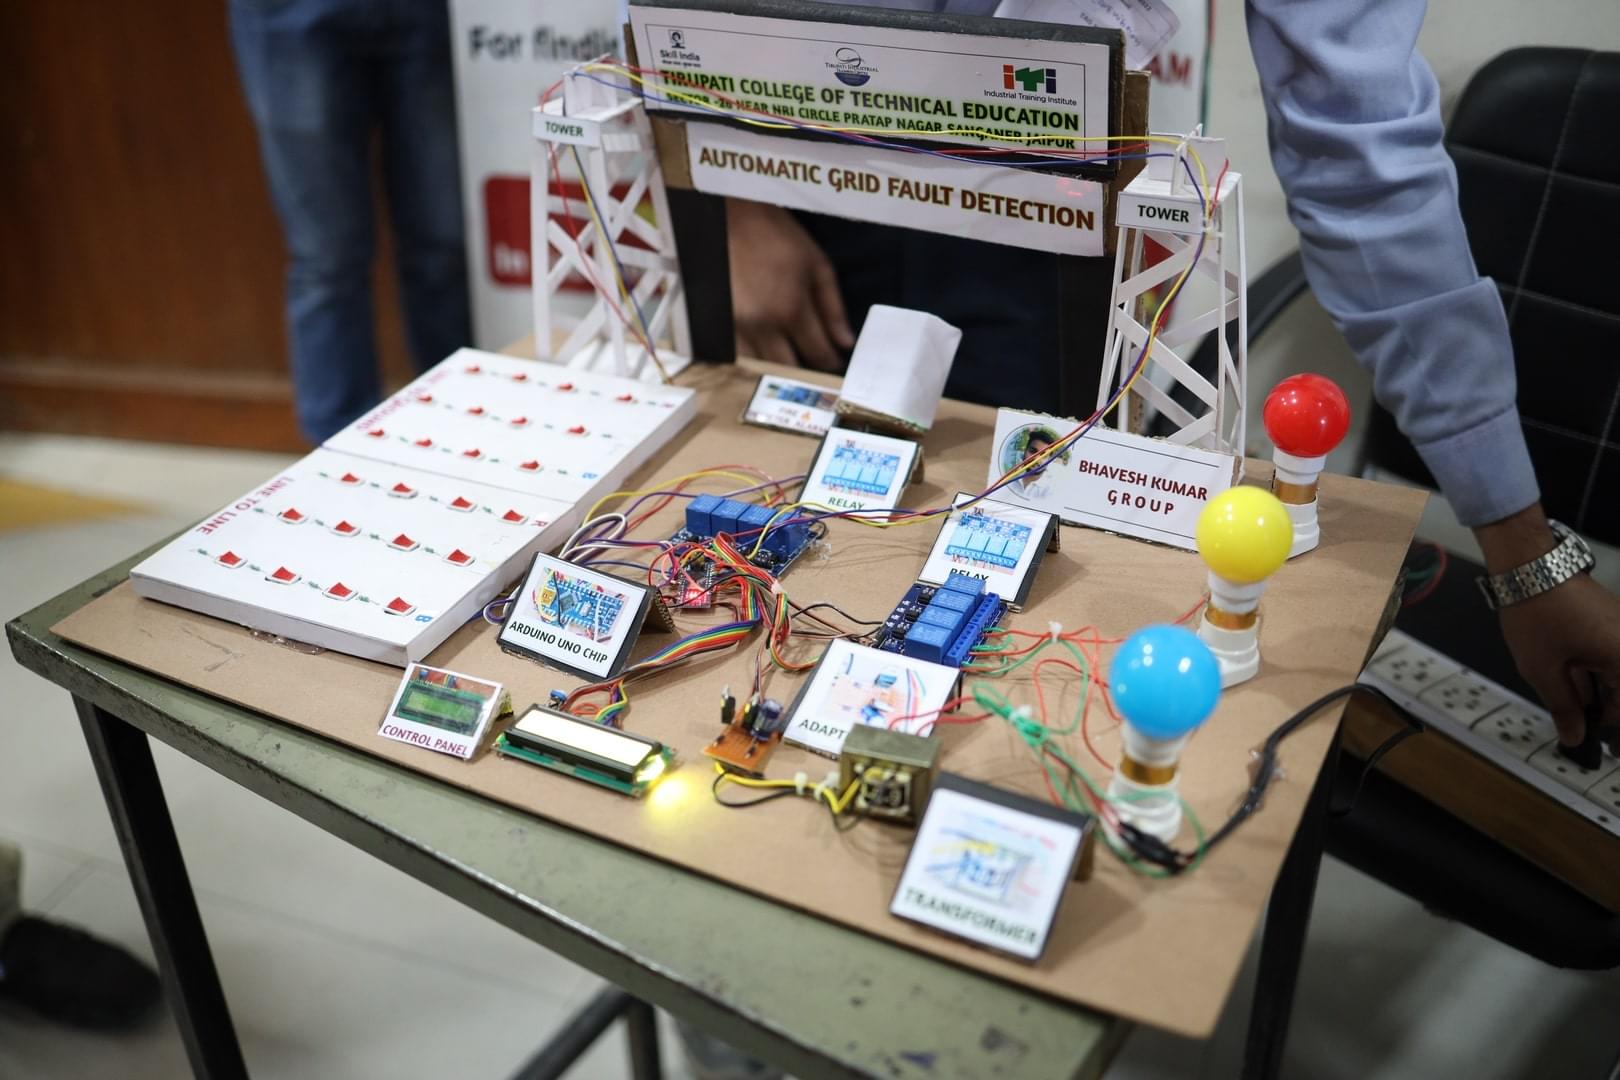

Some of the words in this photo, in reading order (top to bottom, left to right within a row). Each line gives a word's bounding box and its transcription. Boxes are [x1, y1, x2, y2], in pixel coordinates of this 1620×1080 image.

[468, 26, 523, 60] For
[660, 49, 678, 58] Skill
[679, 51, 700, 61] India
[660, 69, 735, 93] TIRUPATI
[739, 78, 816, 104] COLLEGE
[820, 87, 845, 104] OF
[849, 90, 957, 117] TECHNICAL
[963, 102, 1079, 131] EDUCATION
[984, 90, 1016, 99] Industrial
[1018, 92, 1047, 103] Training
[1047, 96, 1077, 106] Institute
[545, 121, 584, 138] TOWER
[772, 104, 795, 117] NRI
[798, 107, 841, 122] CIRCLE
[843, 112, 893, 128] PRATAP
[896, 118, 943, 133] NAGAR
[1025, 132, 1076, 149] JAIPUR
[700, 147, 822, 185] AUTOMATIC
[827, 168, 881, 194] GRID
[888, 177, 953, 206] FAULT
[961, 189, 1095, 231] DETECTION
[1137, 204, 1190, 223] TOWER
[1078, 459, 1148, 487] BHAVESH
[1150, 476, 1208, 501] KUMAR
[828, 496, 865, 510] RELAY
[1107, 489, 1175, 515] GROUP
[195, 510, 238, 536] LINE
[509, 620, 556, 645] ARDUINO
[557, 638, 582, 655] UNO
[583, 648, 609, 664] CHIP
[382, 724, 432, 747] CONTROL
[434, 738, 468, 756] PANEL
[905, 886, 1037, 944] TRANSFORMER
